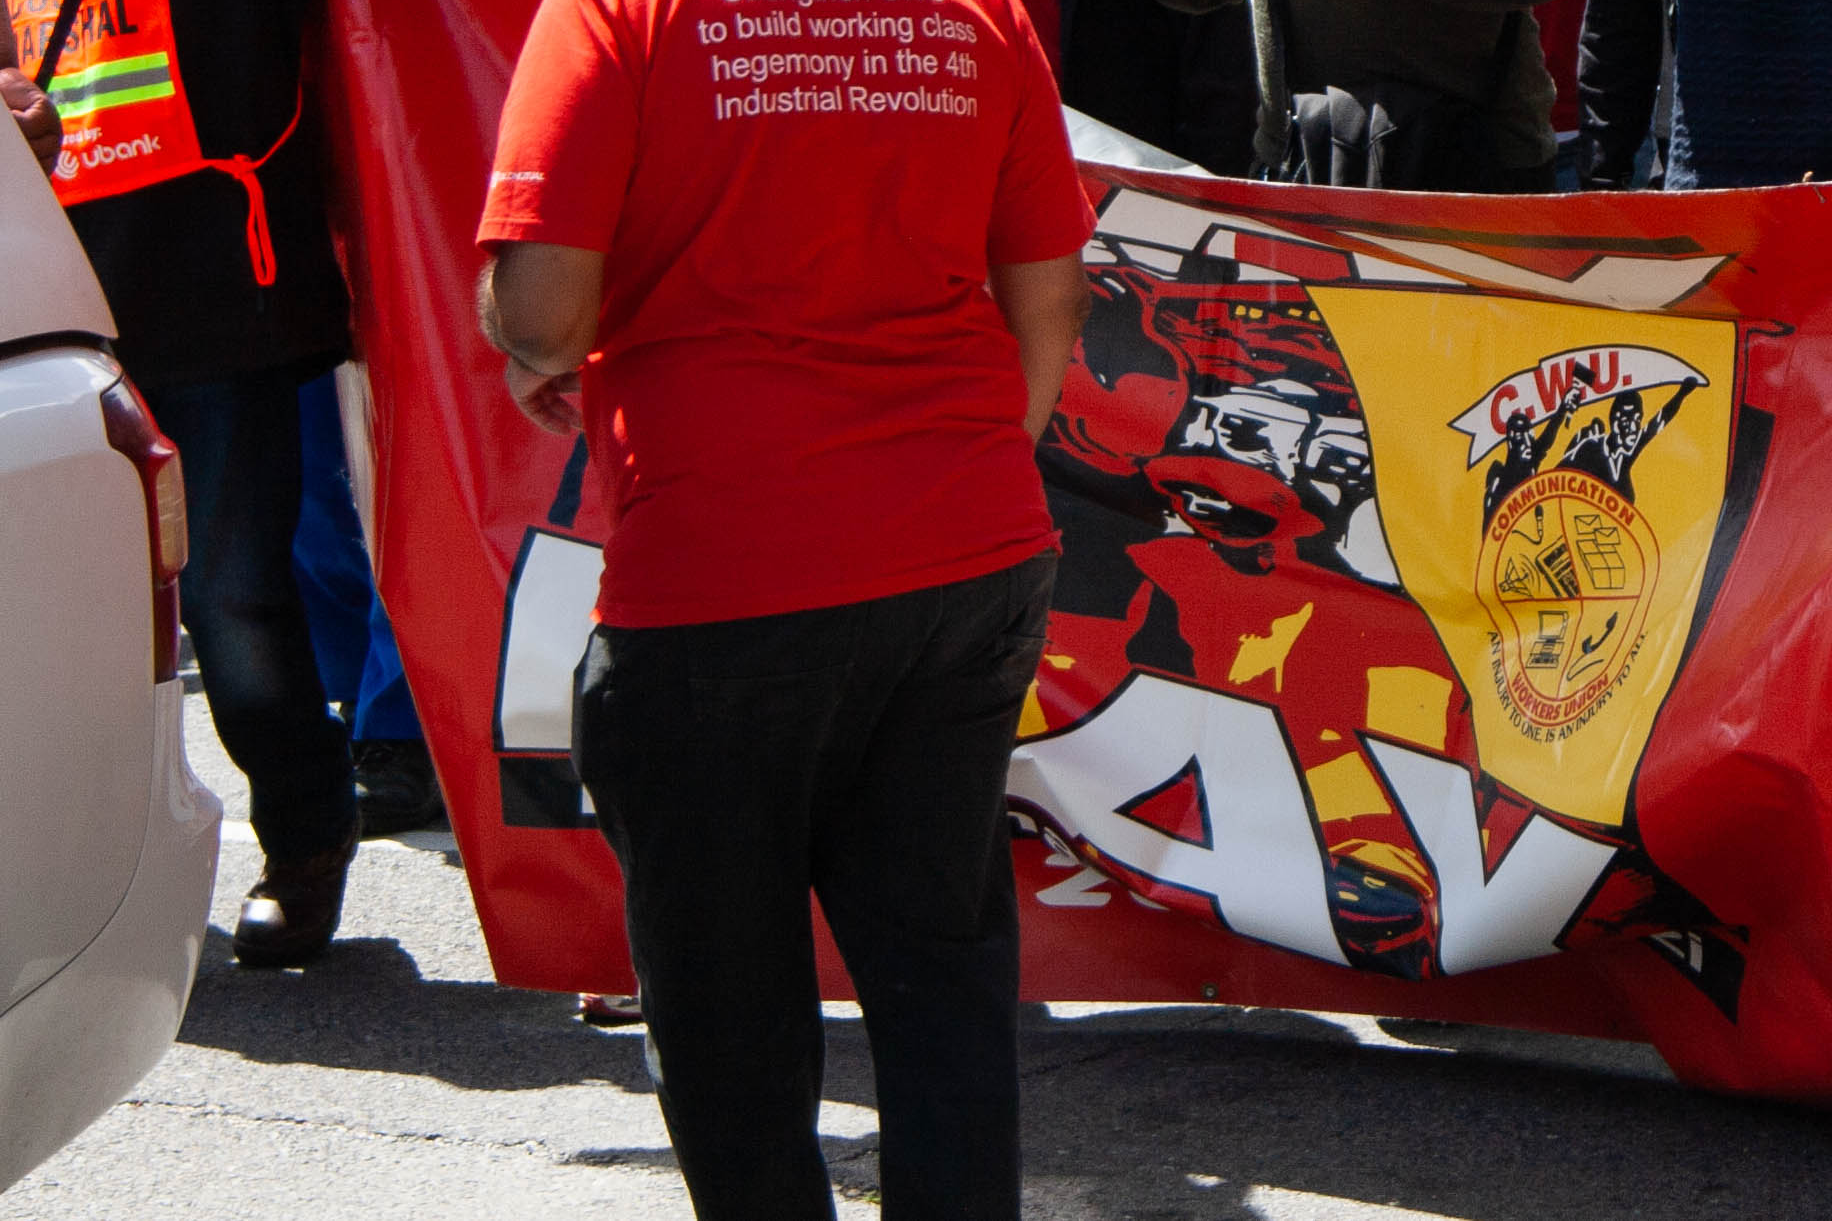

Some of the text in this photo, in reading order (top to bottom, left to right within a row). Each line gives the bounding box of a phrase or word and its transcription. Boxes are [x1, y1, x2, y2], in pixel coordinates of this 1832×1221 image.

[698, 11, 978, 45] to build working class
[711, 48, 978, 83] hegemony in the 4th
[715, 85, 978, 121] Industrial Revolution
[82, 133, 161, 169] ubank
[1490, 475, 1635, 542] COMMUNICATION
[1487, 631, 1501, 655] AN
[1491, 658, 1513, 711] INJURY
[1616, 663, 1632, 687] TO
[1511, 670, 1610, 721] WORKERS UNION
[1574, 690, 1614, 732] INJURY
[1509, 706, 1523, 729] TO
[1558, 724, 1575, 742] AN
[1545, 727, 1556, 744] IS
